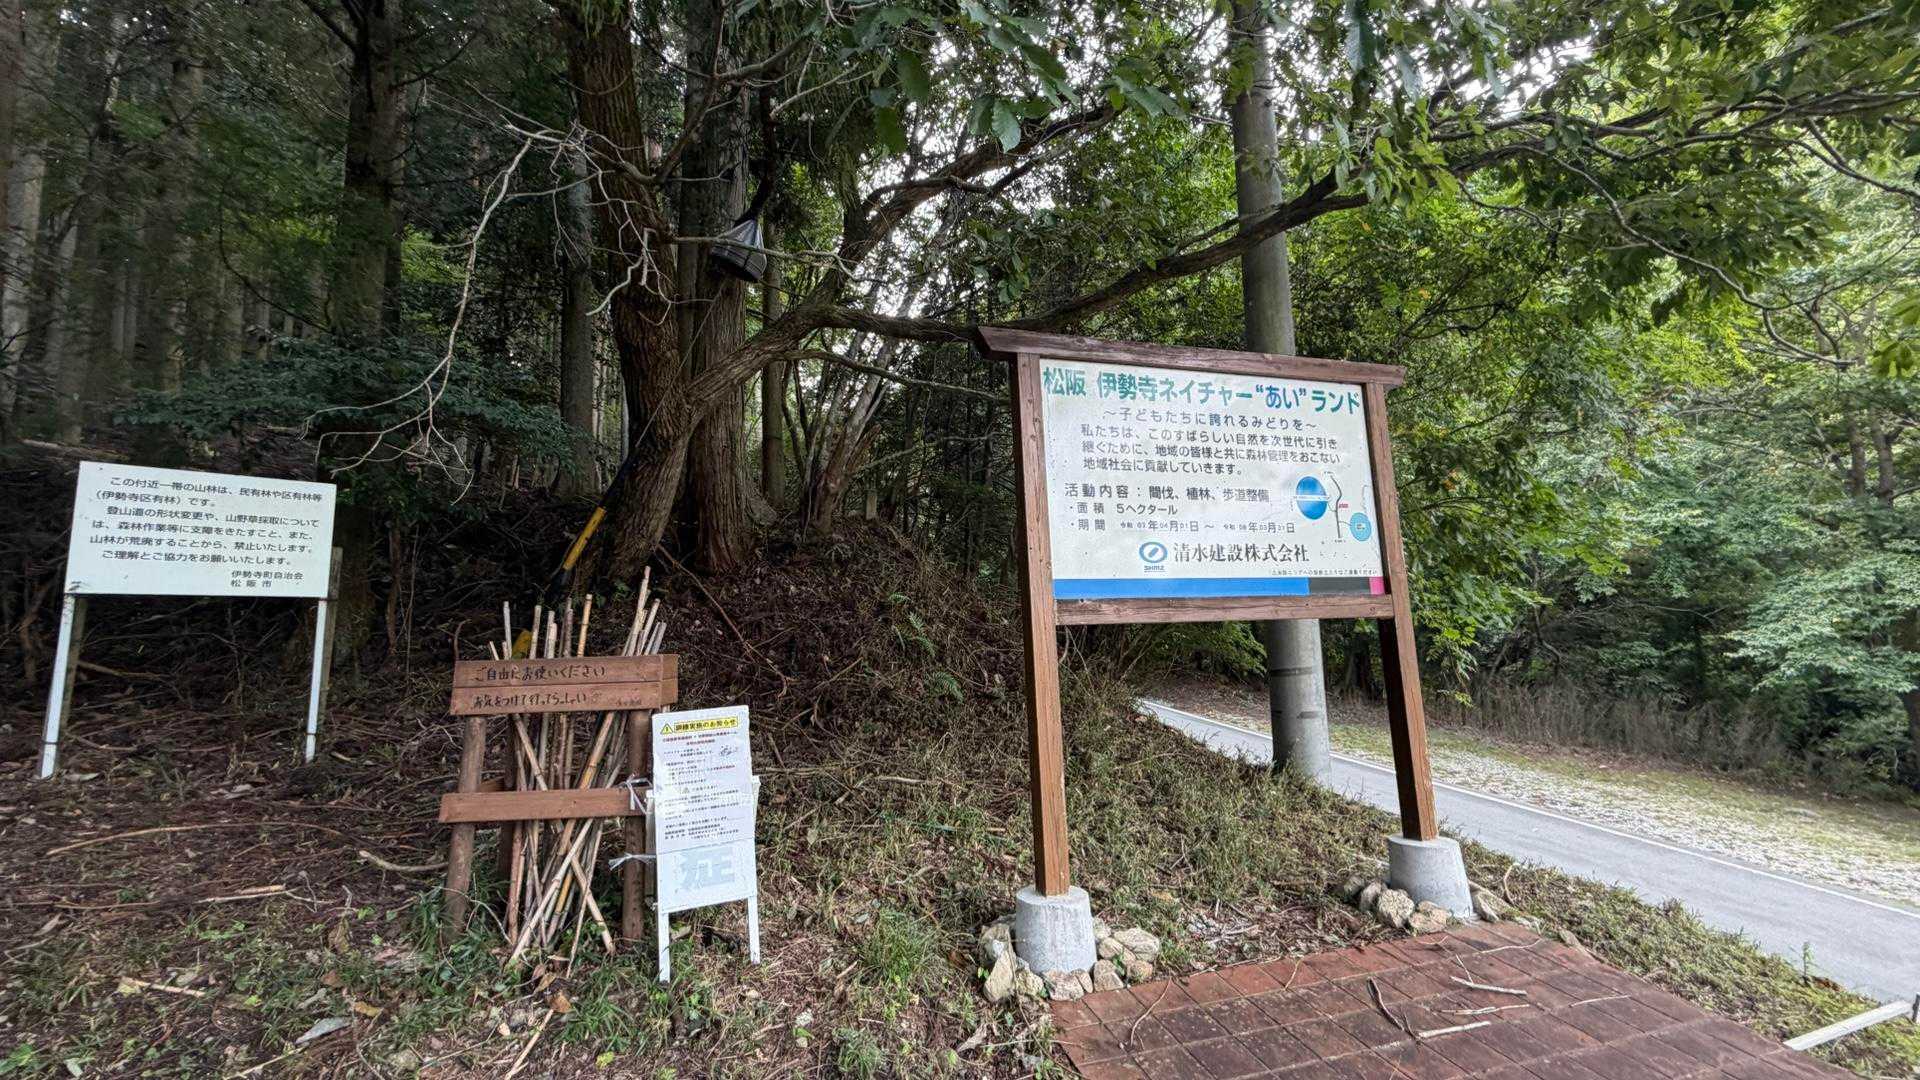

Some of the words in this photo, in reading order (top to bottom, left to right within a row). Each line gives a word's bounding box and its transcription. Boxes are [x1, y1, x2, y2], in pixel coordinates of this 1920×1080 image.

[1043, 367, 1086, 396] 松阪
[1081, 424, 1337, 449] 私たちは、このすばらしい自然を次世代に引き
[1082, 441, 1340, 464] 継ぐために、地域の皆様と共に森林管理をおこない
[1083, 457, 1242, 476] 地域社会に貢献していきます。
[110, 477, 322, 503] この付近一帯の山林は、民有林や区有林等
[106, 506, 320, 527] 登山道の形状変更や、山野草採取について
[89, 535, 312, 553] 山林が荒廃することから、禁止いたします。
[1174, 542, 1310, 563] 清水建設株式会社
[102, 550, 291, 566] ご理解とご協力をお願いいたします。
